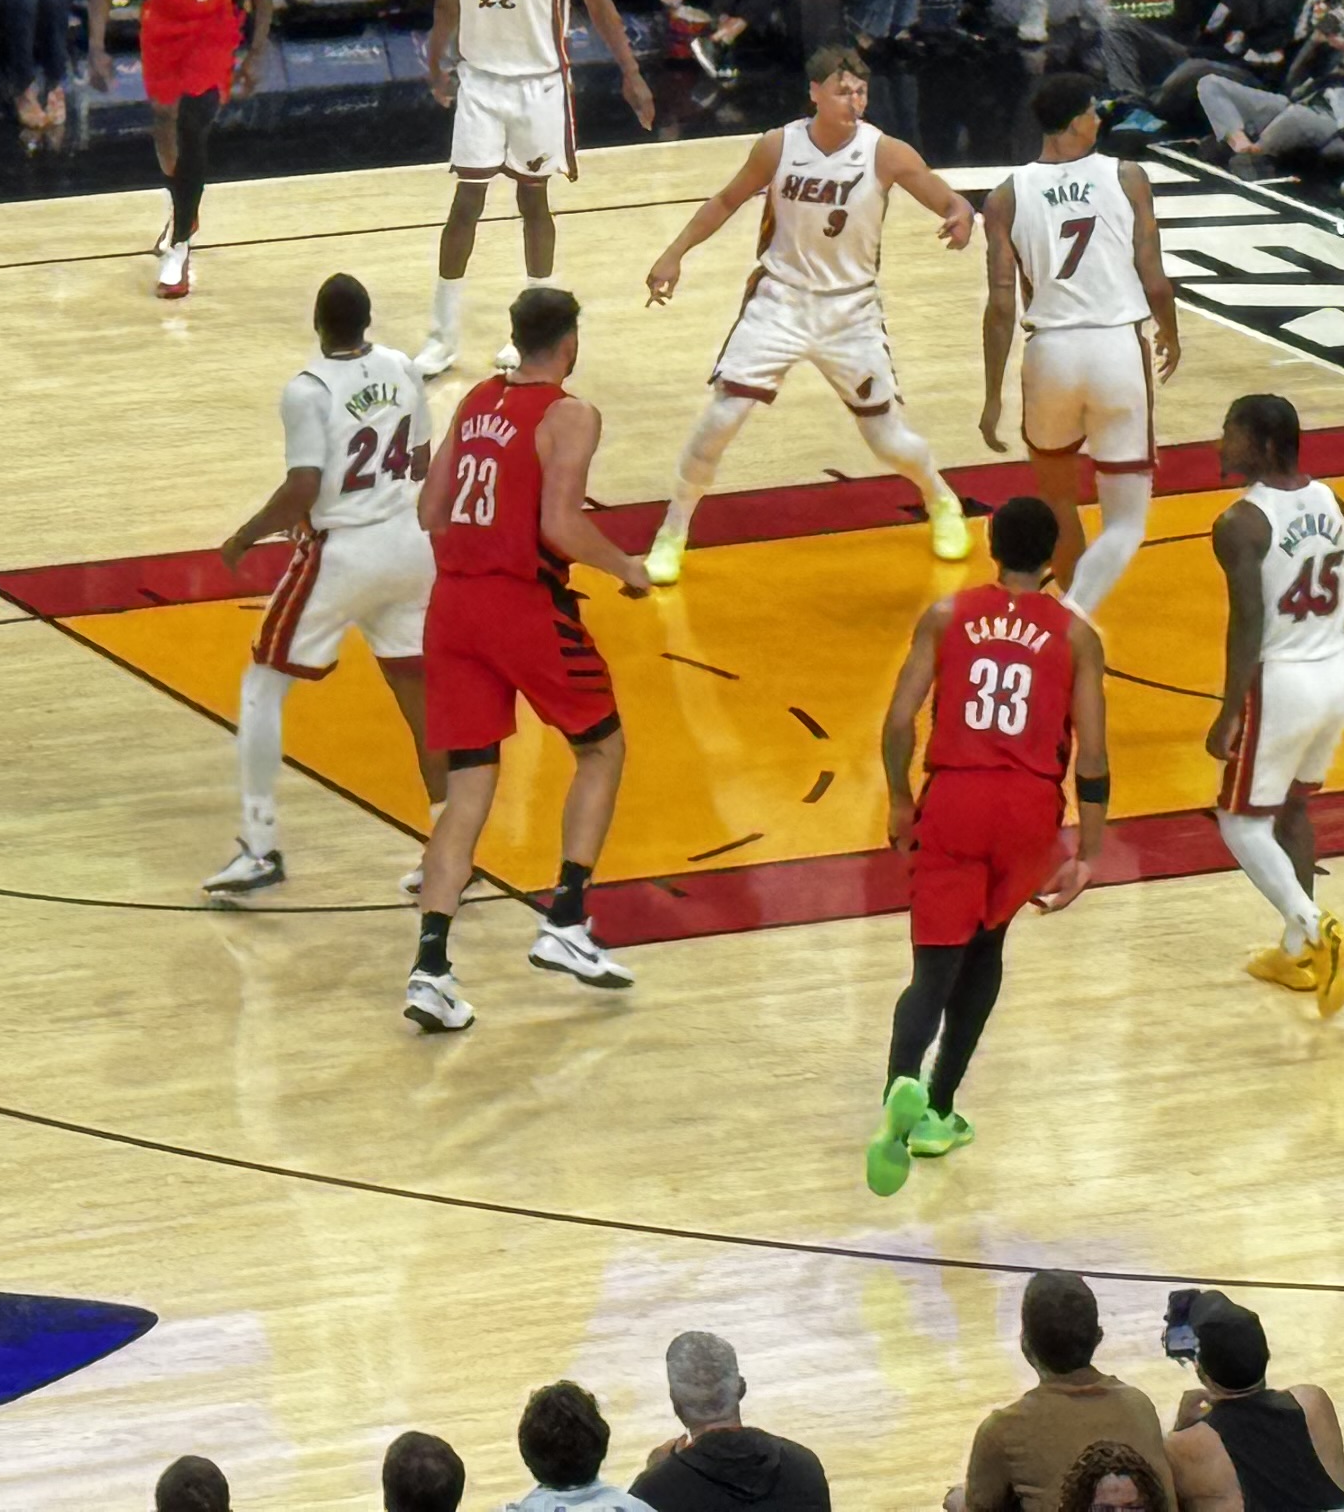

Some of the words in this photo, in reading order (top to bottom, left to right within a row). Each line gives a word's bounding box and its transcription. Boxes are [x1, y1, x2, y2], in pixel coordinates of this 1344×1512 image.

[781, 172, 864, 207] HEAT
[1043, 183, 1094, 206] WARE
[822, 209, 848, 238] 9
[1055, 215, 1097, 280] 7
[339, 414, 412, 496] 24
[451, 454, 498, 527] 23
[964, 616, 1052, 655] CAMARA
[964, 657, 1033, 736] 33
